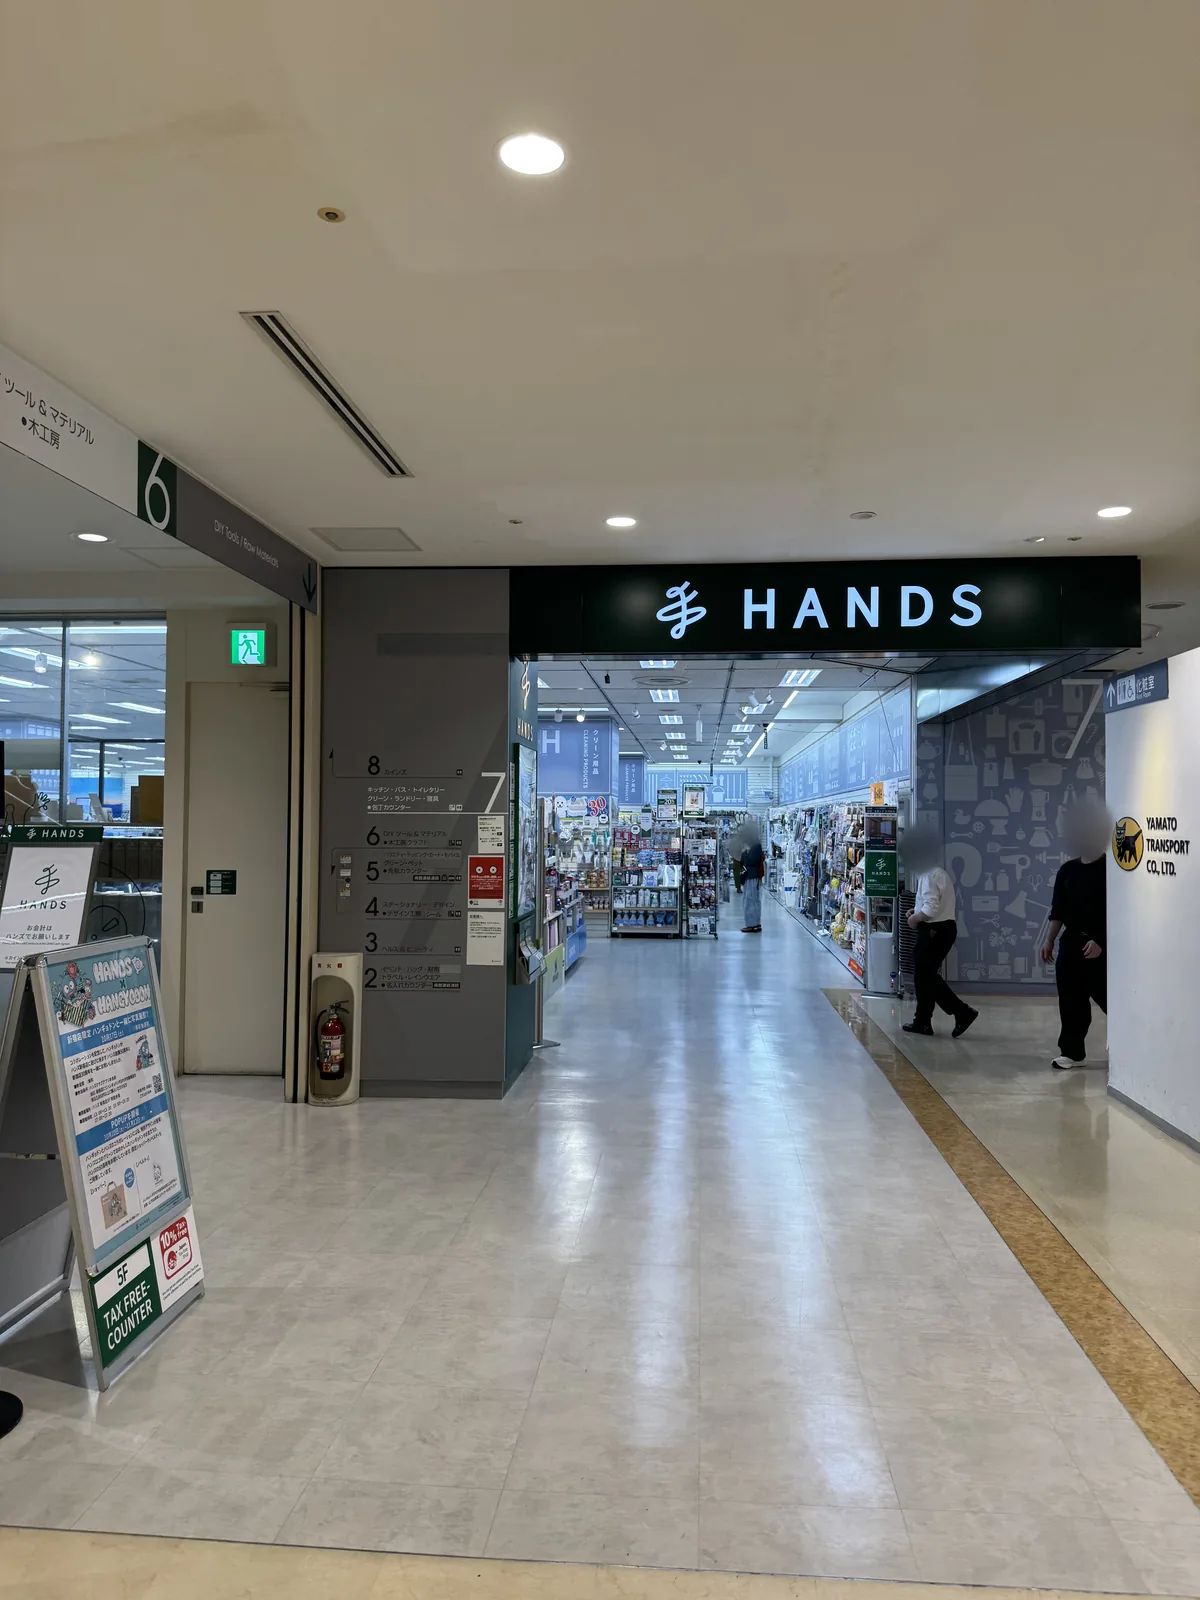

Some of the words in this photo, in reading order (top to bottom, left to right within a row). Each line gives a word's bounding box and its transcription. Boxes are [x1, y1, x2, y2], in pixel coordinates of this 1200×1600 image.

[38, 399, 48, 417] &
[50, 405, 95, 446] マテリアル
[28, 417, 61, 450] 木工房
[144, 453, 171, 531] 6
[226, 526, 240, 545] Tools
[255, 546, 279, 569] Materials
[743, 584, 983, 630] HANDS
[517, 717, 533, 742] HANDS
[542, 729, 560, 754] H
[367, 755, 381, 776] 8
[481, 772, 506, 814] 7
[42, 829, 85, 838] HANDS
[1146, 817, 1177, 832] YAMATO
[366, 826, 380, 846] 6
[1146, 838, 1191, 856] TRANSPORT
[366, 861, 380, 881] 5
[1161, 861, 1177, 877] LTD.
[19, 900, 68, 910] HANDS
[364, 896, 379, 917] 4
[5, 933, 71, 941] ハンズでお願いします
[364, 932, 378, 953] 3
[93, 957, 132, 984] HANDS
[364, 968, 377, 988] 2
[160, 1231, 177, 1250] 10%
[116, 1262, 129, 1286] 5F
[103, 1301, 124, 1330] TAX
[107, 1298, 153, 1350] COUNTER
